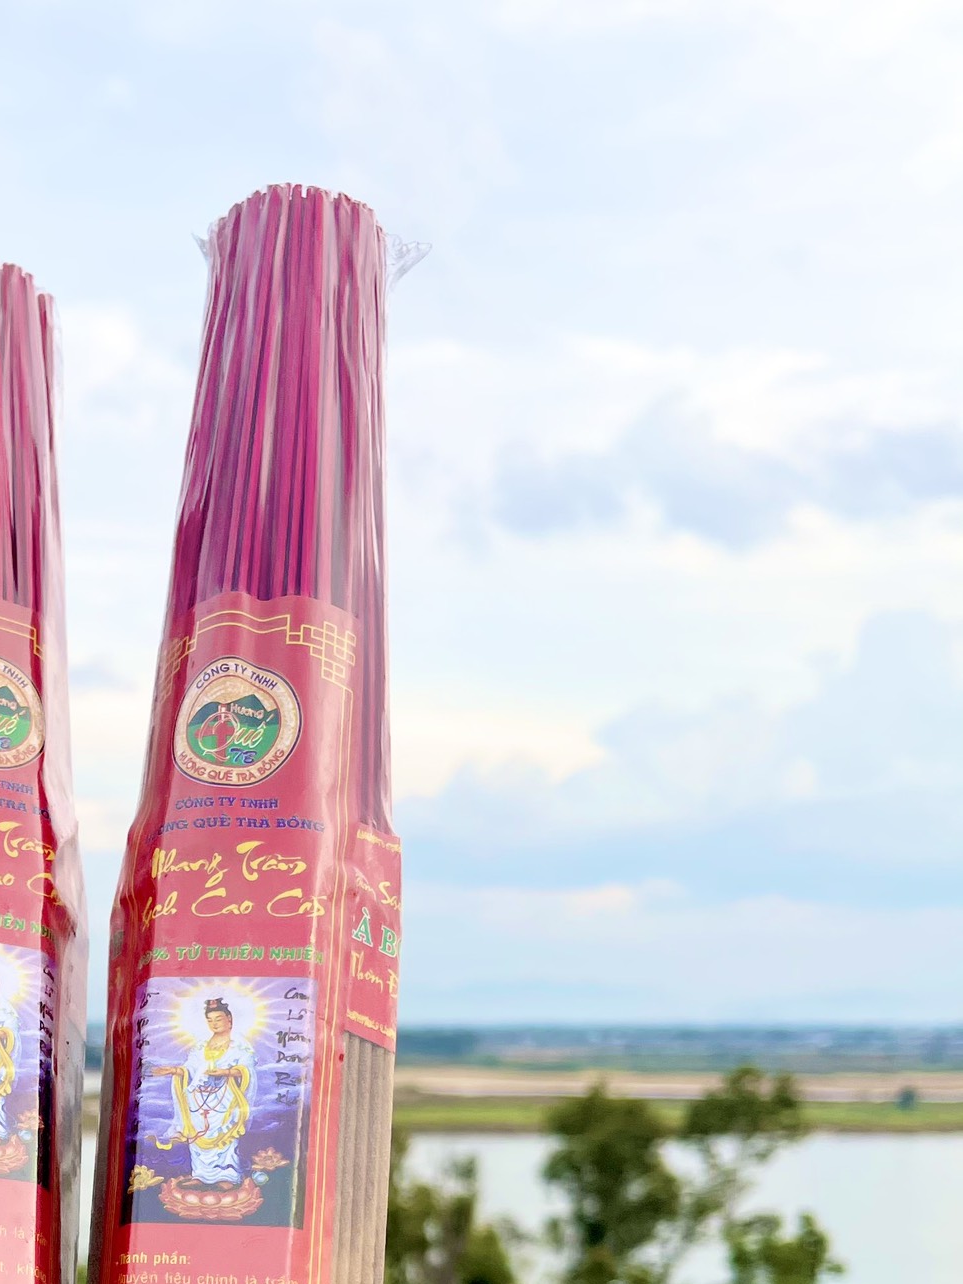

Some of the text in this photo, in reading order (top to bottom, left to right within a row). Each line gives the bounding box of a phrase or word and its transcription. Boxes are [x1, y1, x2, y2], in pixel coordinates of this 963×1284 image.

[2, 665, 28, 689] TNHH
[196, 663, 277, 690] CÔNG TY TNHH
[175, 796, 279, 810] CÔNG TY TNHH
[236, 840, 307, 881] Trầm
[191, 887, 254, 917] Cao
[207, 944, 264, 961] THIÊN
